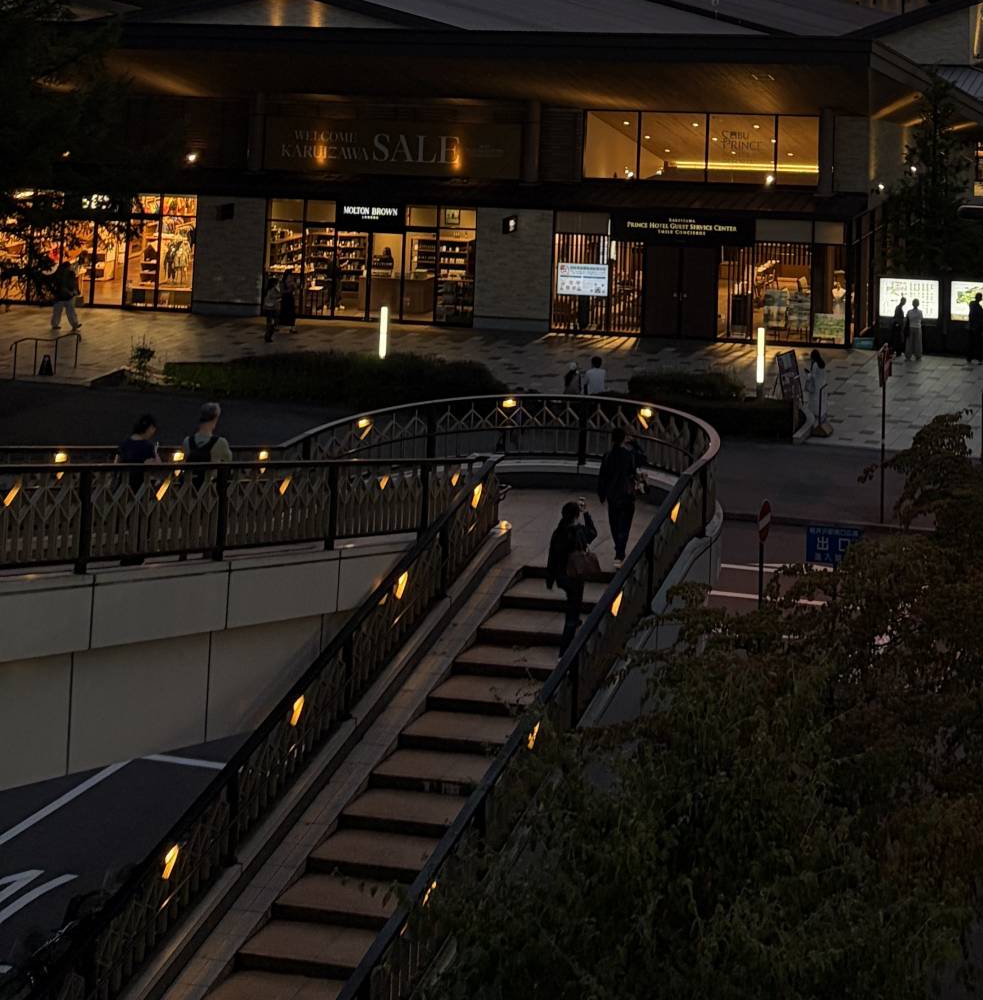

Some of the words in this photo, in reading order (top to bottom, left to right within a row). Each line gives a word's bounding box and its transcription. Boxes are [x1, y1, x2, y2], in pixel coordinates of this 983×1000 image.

[293, 129, 359, 145] WELCOME
[281, 143, 369, 161] KARUIZAWA
[372, 132, 461, 165] SALE
[720, 138, 764, 152] PRINCE
[342, 205, 370, 216] MOLTON
[371, 206, 399, 217] BROWN
[626, 221, 648, 229] PRINCE
[649, 221, 669, 230] HOTEL
[689, 223, 713, 232] SERVICE
[713, 224, 738, 233] CENTER
